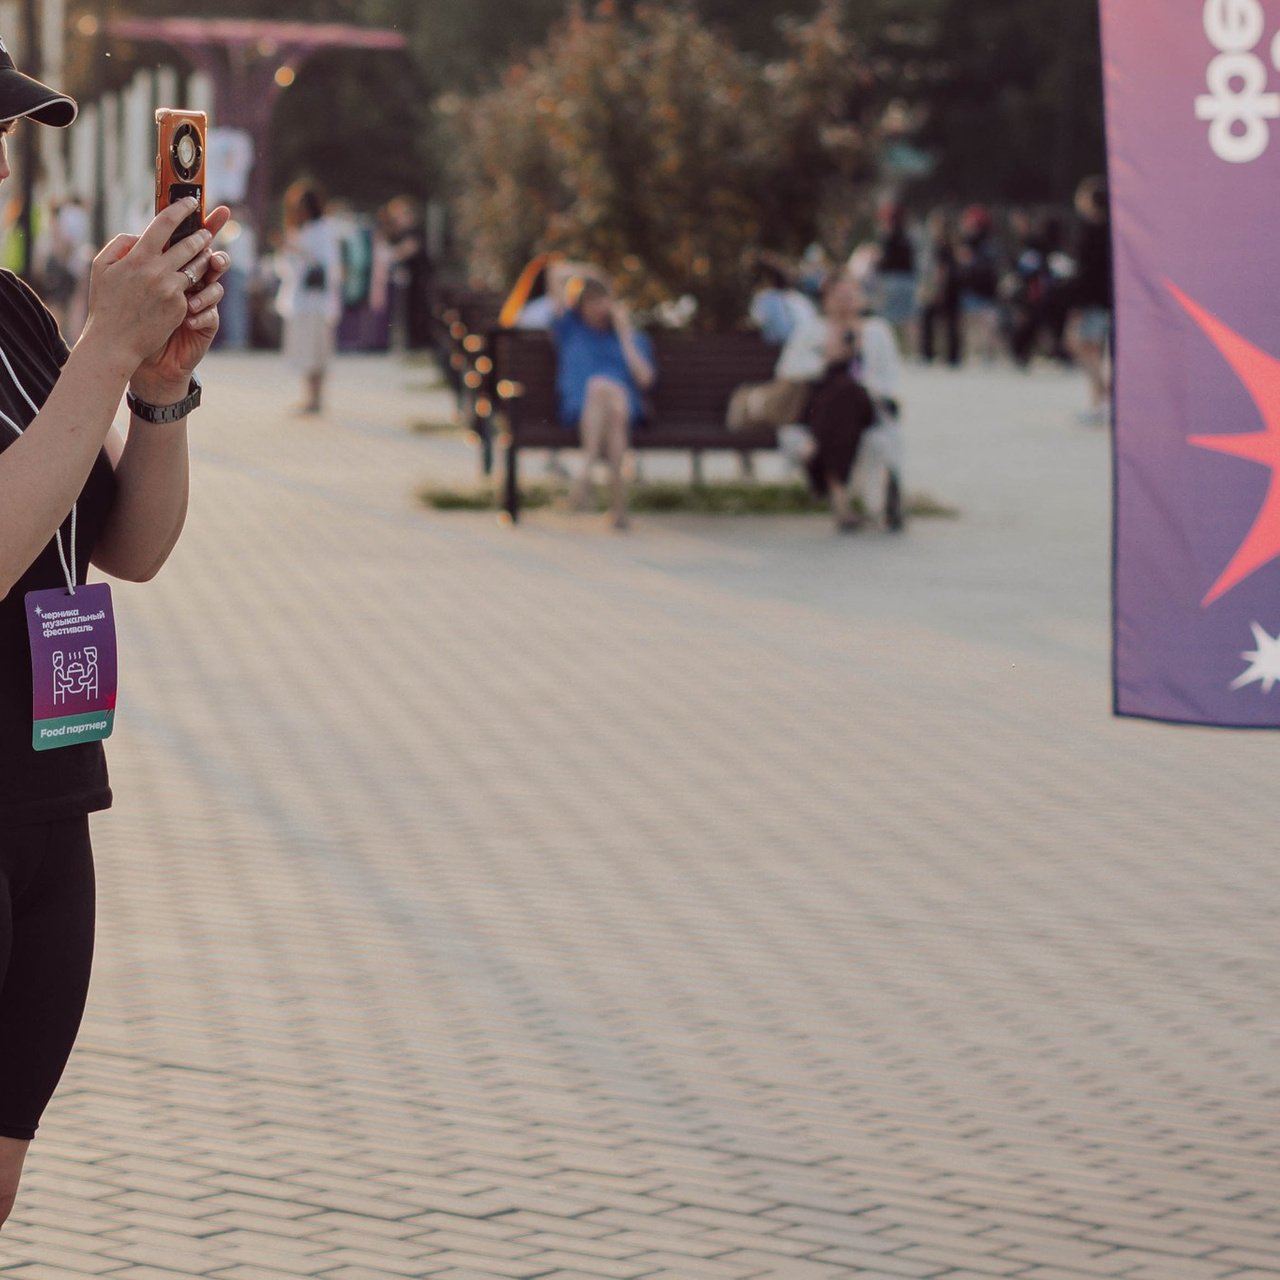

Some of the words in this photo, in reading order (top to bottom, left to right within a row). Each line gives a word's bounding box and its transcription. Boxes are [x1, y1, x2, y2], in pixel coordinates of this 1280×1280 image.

[41, 609, 79, 620] черника
[42, 610, 105, 629] музыкальный
[43, 625, 93, 638] фестиваль
[40, 725, 65, 738] Food
[66, 720, 107, 734] партнер
